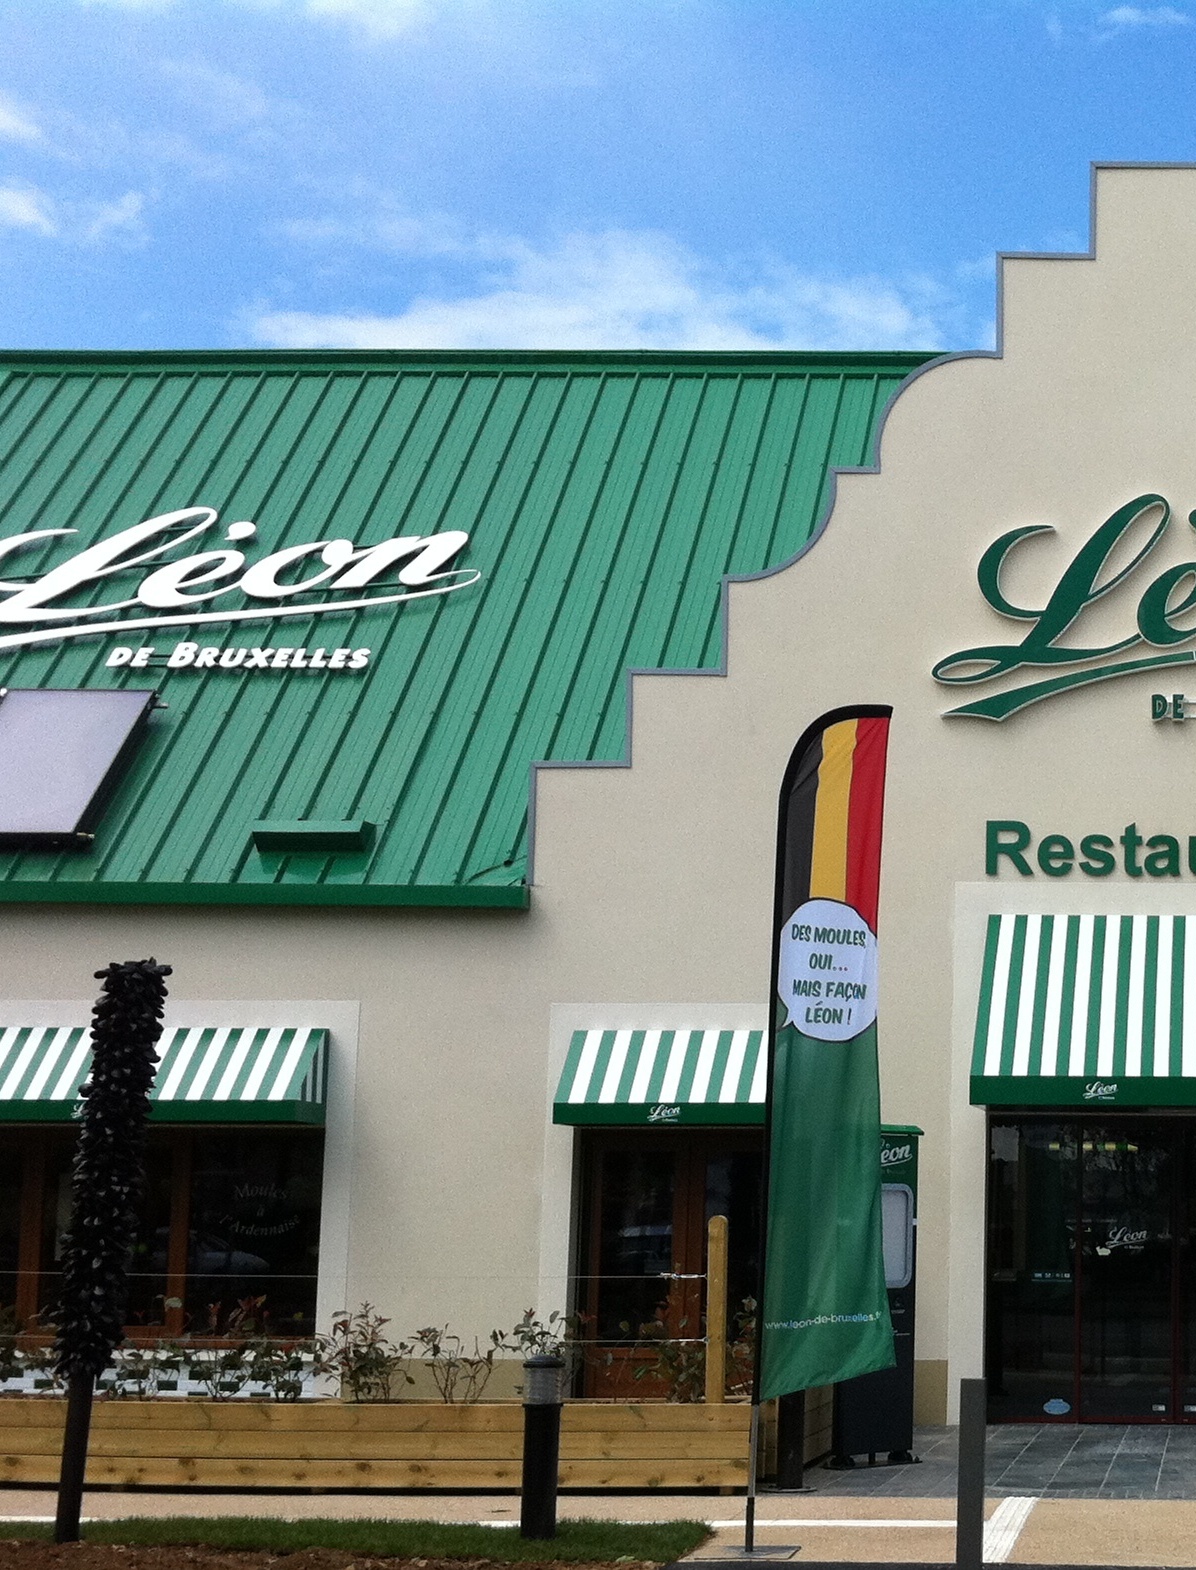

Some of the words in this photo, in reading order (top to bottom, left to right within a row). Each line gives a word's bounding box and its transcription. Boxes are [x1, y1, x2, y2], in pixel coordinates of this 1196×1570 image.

[105, 647, 155, 667] DE
[1151, 694, 1185, 721] DE
[791, 923, 812, 942] DES
[809, 952, 848, 970] OUI...
[792, 979, 822, 998] MAIS
[825, 982, 867, 1002] FAÇON
[805, 1001, 843, 1024] LÉON
[881, 1138, 913, 1166] éon
